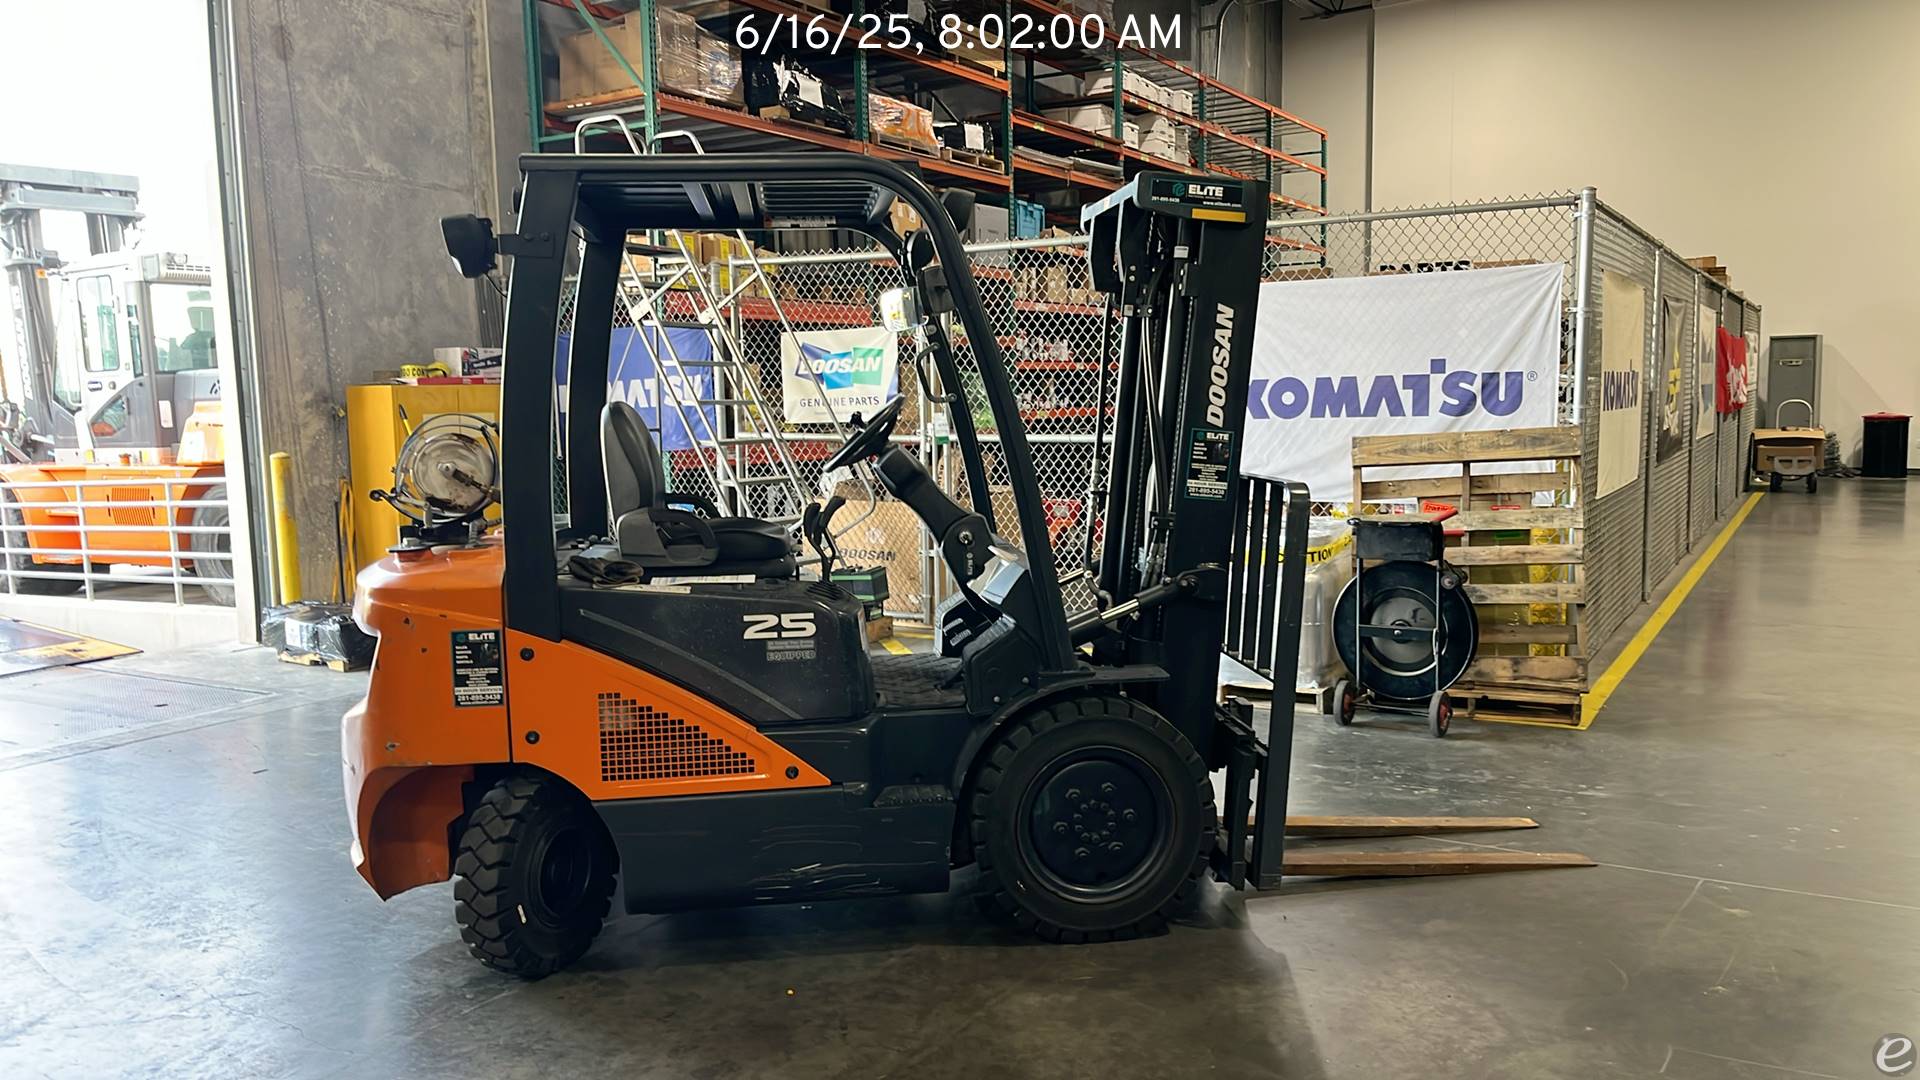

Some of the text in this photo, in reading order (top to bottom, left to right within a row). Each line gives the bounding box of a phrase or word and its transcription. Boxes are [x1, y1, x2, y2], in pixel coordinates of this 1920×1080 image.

[1188, 184, 1224, 197] ELITE
[1206, 303, 1235, 428] DOOSAN
[1246, 358, 1524, 419] KOMATSU
[800, 395, 880, 407] GENINE PARTS
[1206, 432, 1229, 440] ELITE
[743, 612, 817, 640] 25
[468, 632, 495, 640] ELITE
